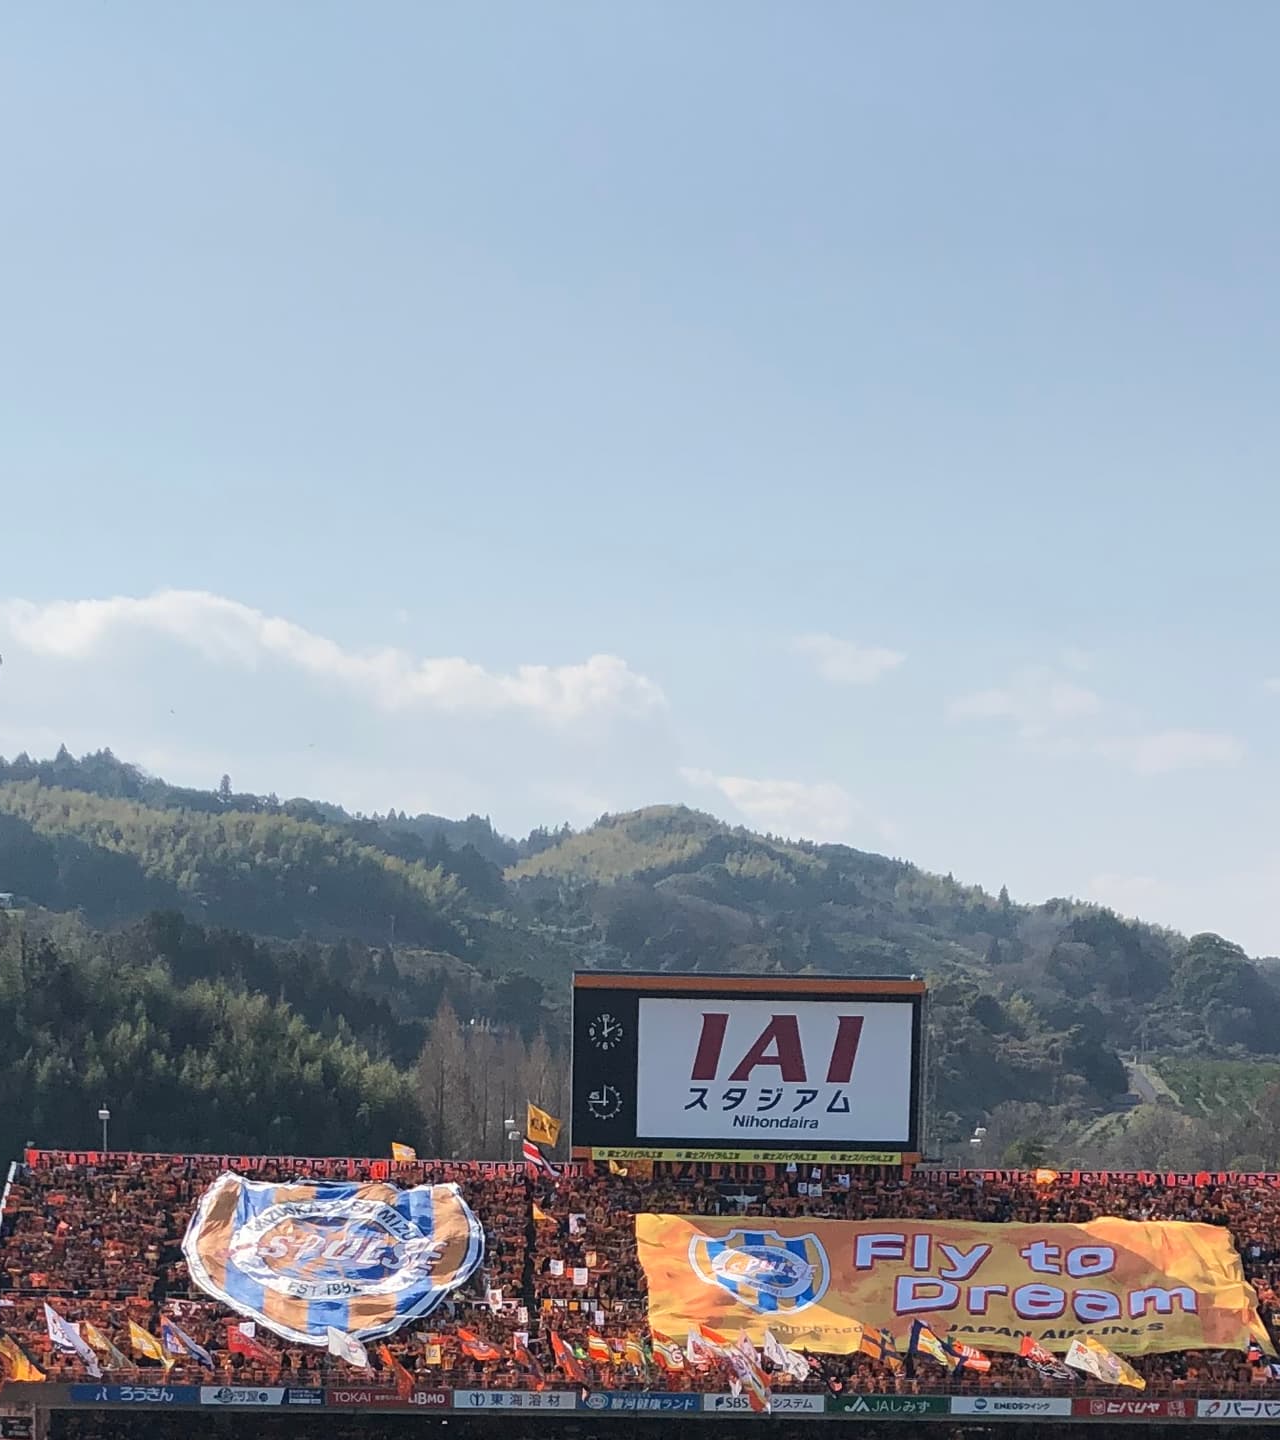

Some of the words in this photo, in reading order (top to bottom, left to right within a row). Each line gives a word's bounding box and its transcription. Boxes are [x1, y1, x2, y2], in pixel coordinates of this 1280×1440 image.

[691, 1013, 864, 1083] IAI
[684, 1087, 851, 1113] スタジアム
[732, 1115, 819, 1130] Nihondaira
[853, 1232, 993, 1281] Fly
[1022, 1239, 1117, 1279] to
[893, 1275, 1199, 1324] Dream
[945, 1323, 1033, 1341] JAPAN
[119, 1387, 174, 1402] ろうきん
[332, 1391, 371, 1404] TOKAI
[490, 1392, 561, 1407] 東海溶材
[610, 1396, 696, 1411] 駿河健康ランド
[725, 1396, 750, 1409] SBS
[773, 1398, 814, 1410] システム
[871, 1399, 931, 1414] JAしみず
